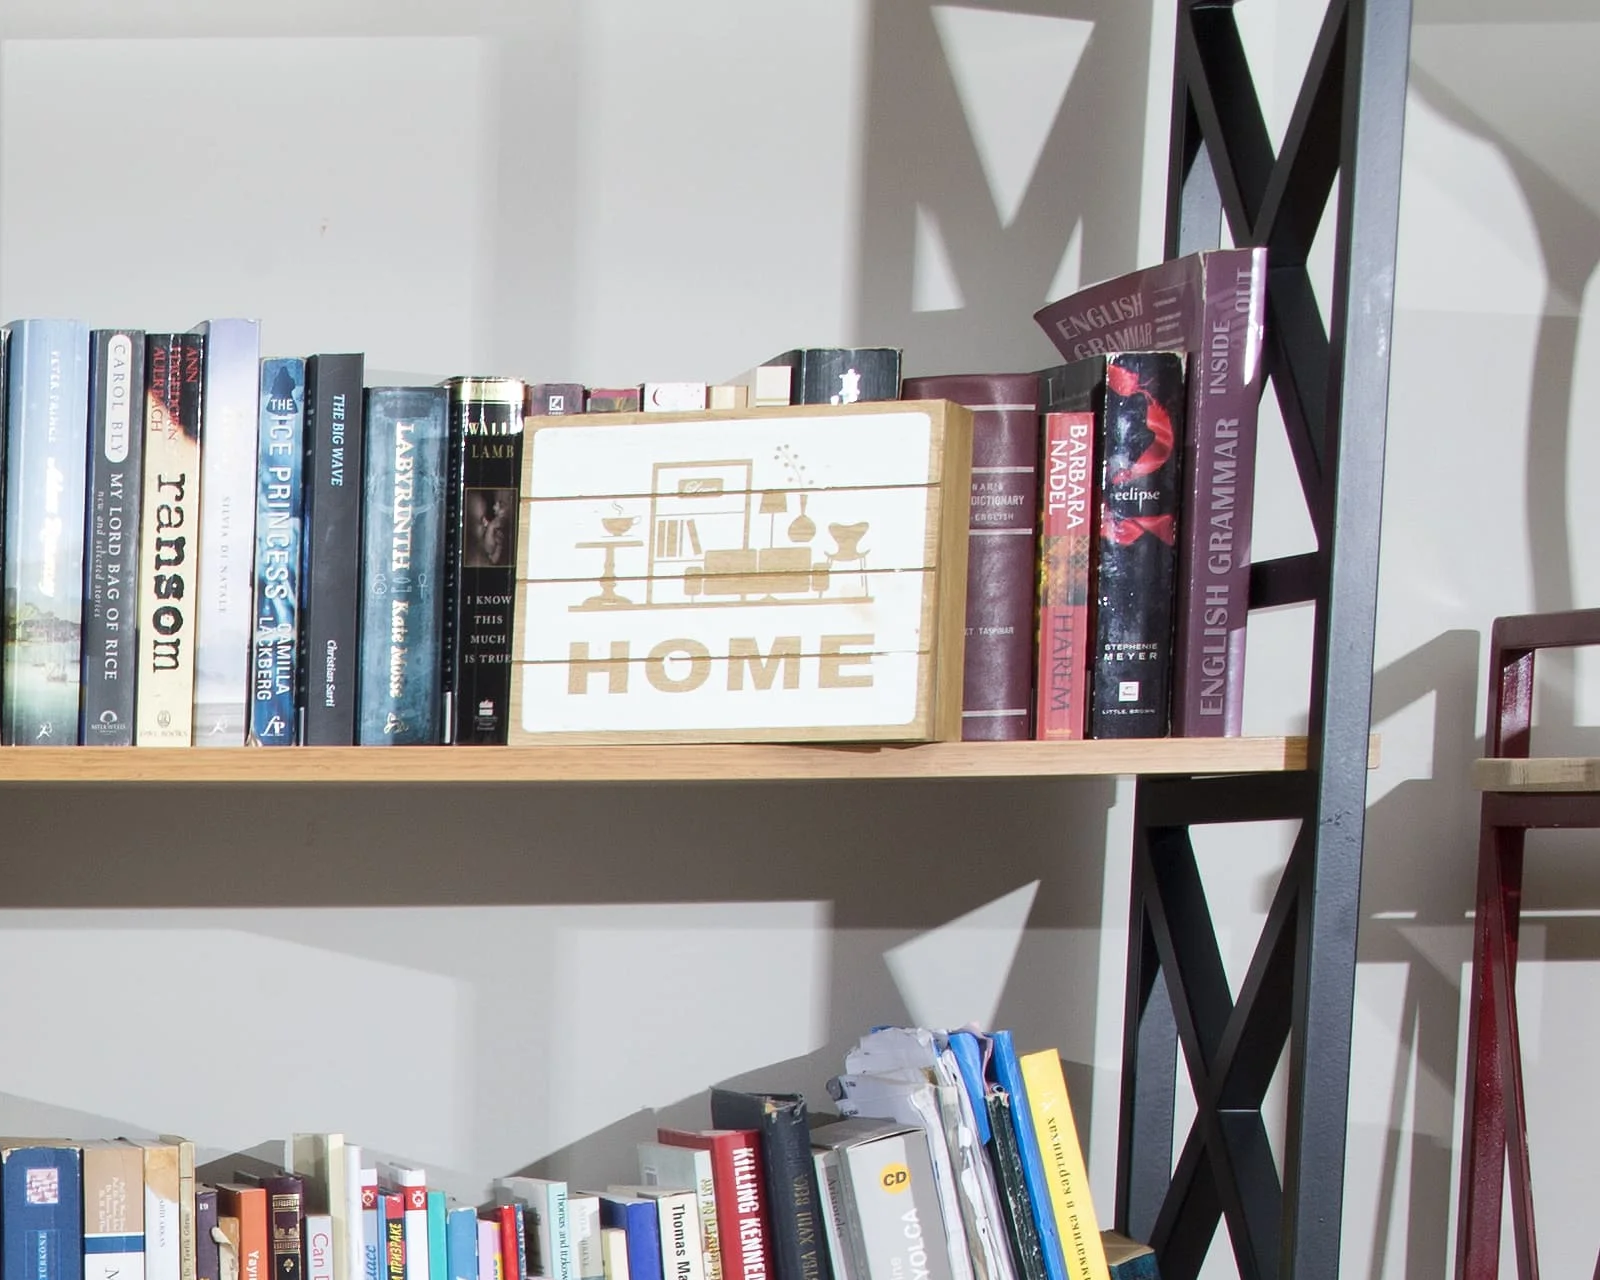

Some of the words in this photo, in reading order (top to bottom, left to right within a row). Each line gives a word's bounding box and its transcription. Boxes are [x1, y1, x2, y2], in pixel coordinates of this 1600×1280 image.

[1210, 321, 1231, 395] INSIDE
[331, 394, 345, 421] THE
[269, 415, 293, 456] ICE
[331, 423, 344, 445] BIG
[109, 474, 122, 506] MY
[329, 448, 344, 487] WAVE
[1048, 440, 1067, 516] NADEL
[1066, 424, 1088, 529] BARBARA
[391, 421, 415, 572] LABYRINTH
[1115, 489, 1160, 502] eclipse
[1207, 417, 1240, 574] GRAMMAR
[108, 512, 122, 558] LORD
[264, 467, 292, 599] PRINCESS
[106, 564, 121, 602] BAG
[151, 472, 187, 673] ransom
[106, 608, 120, 632] OF
[104, 639, 120, 681] RICE
[274, 623, 292, 696] CAMILLA
[567, 632, 876, 695] HOME
[1050, 614, 1072, 713] HAREM
[1104, 652, 1159, 662] MEYER
[1199, 586, 1227, 716] ENGLISH
[731, 1148, 761, 1213] KILLING
[883, 1173, 907, 1186] CD
[312, 1232, 329, 1268] Can
[672, 1204, 688, 1257] Thomas
